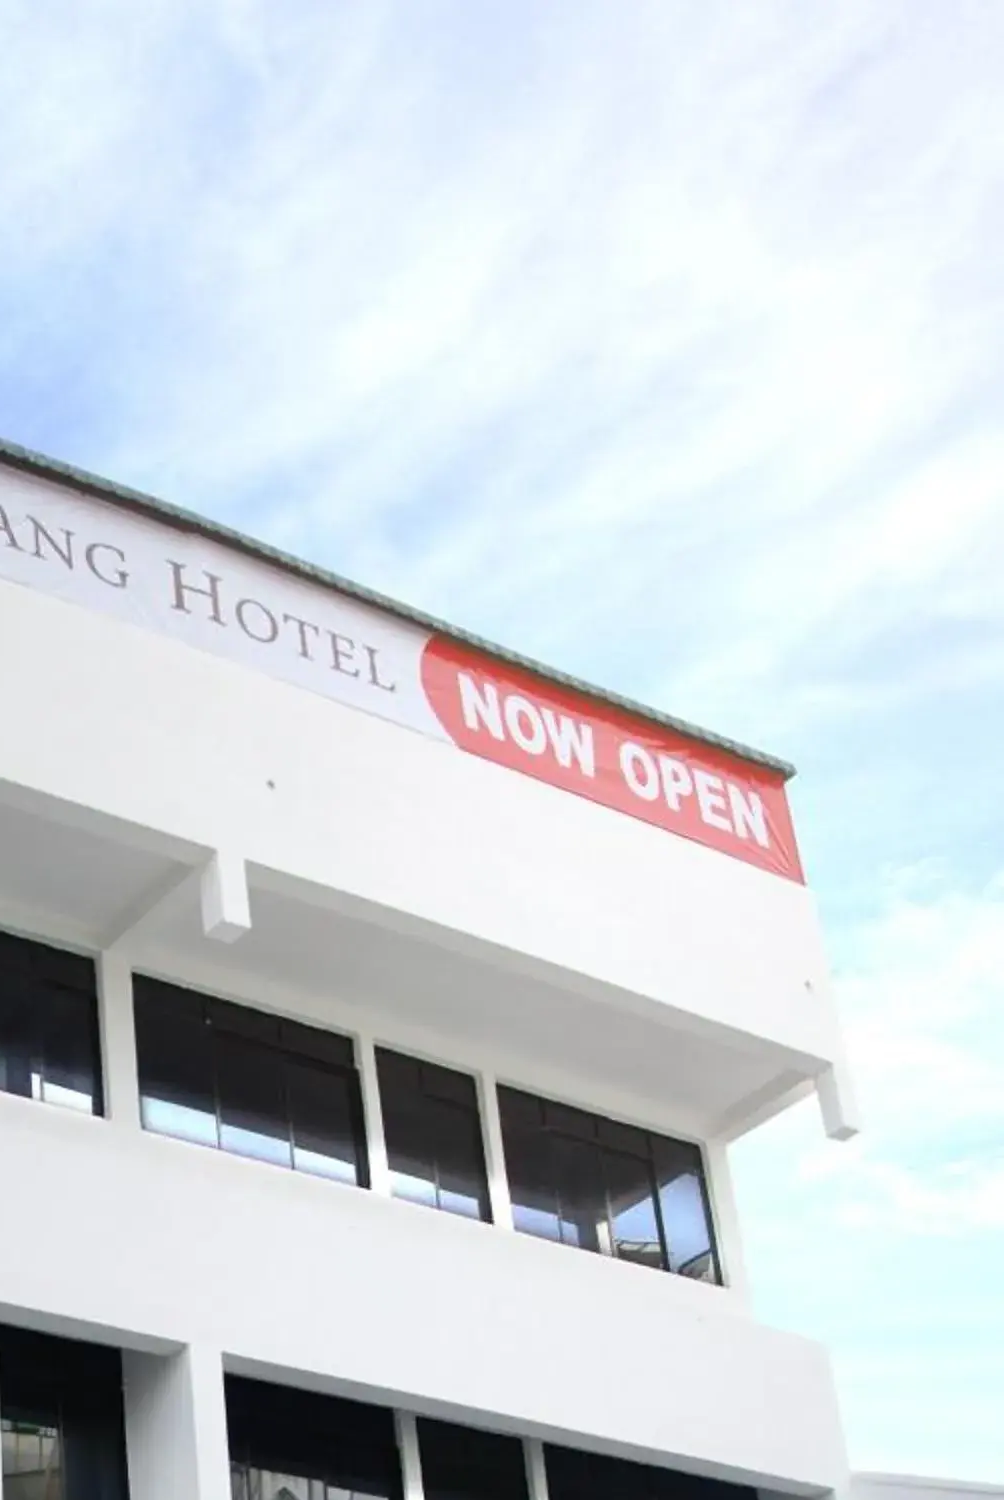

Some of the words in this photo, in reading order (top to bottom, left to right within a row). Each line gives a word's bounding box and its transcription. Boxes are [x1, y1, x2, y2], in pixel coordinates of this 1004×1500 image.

[164, 557, 397, 694] HOTEL
[456, 671, 597, 780] NOW
[618, 740, 771, 849] OPEN
